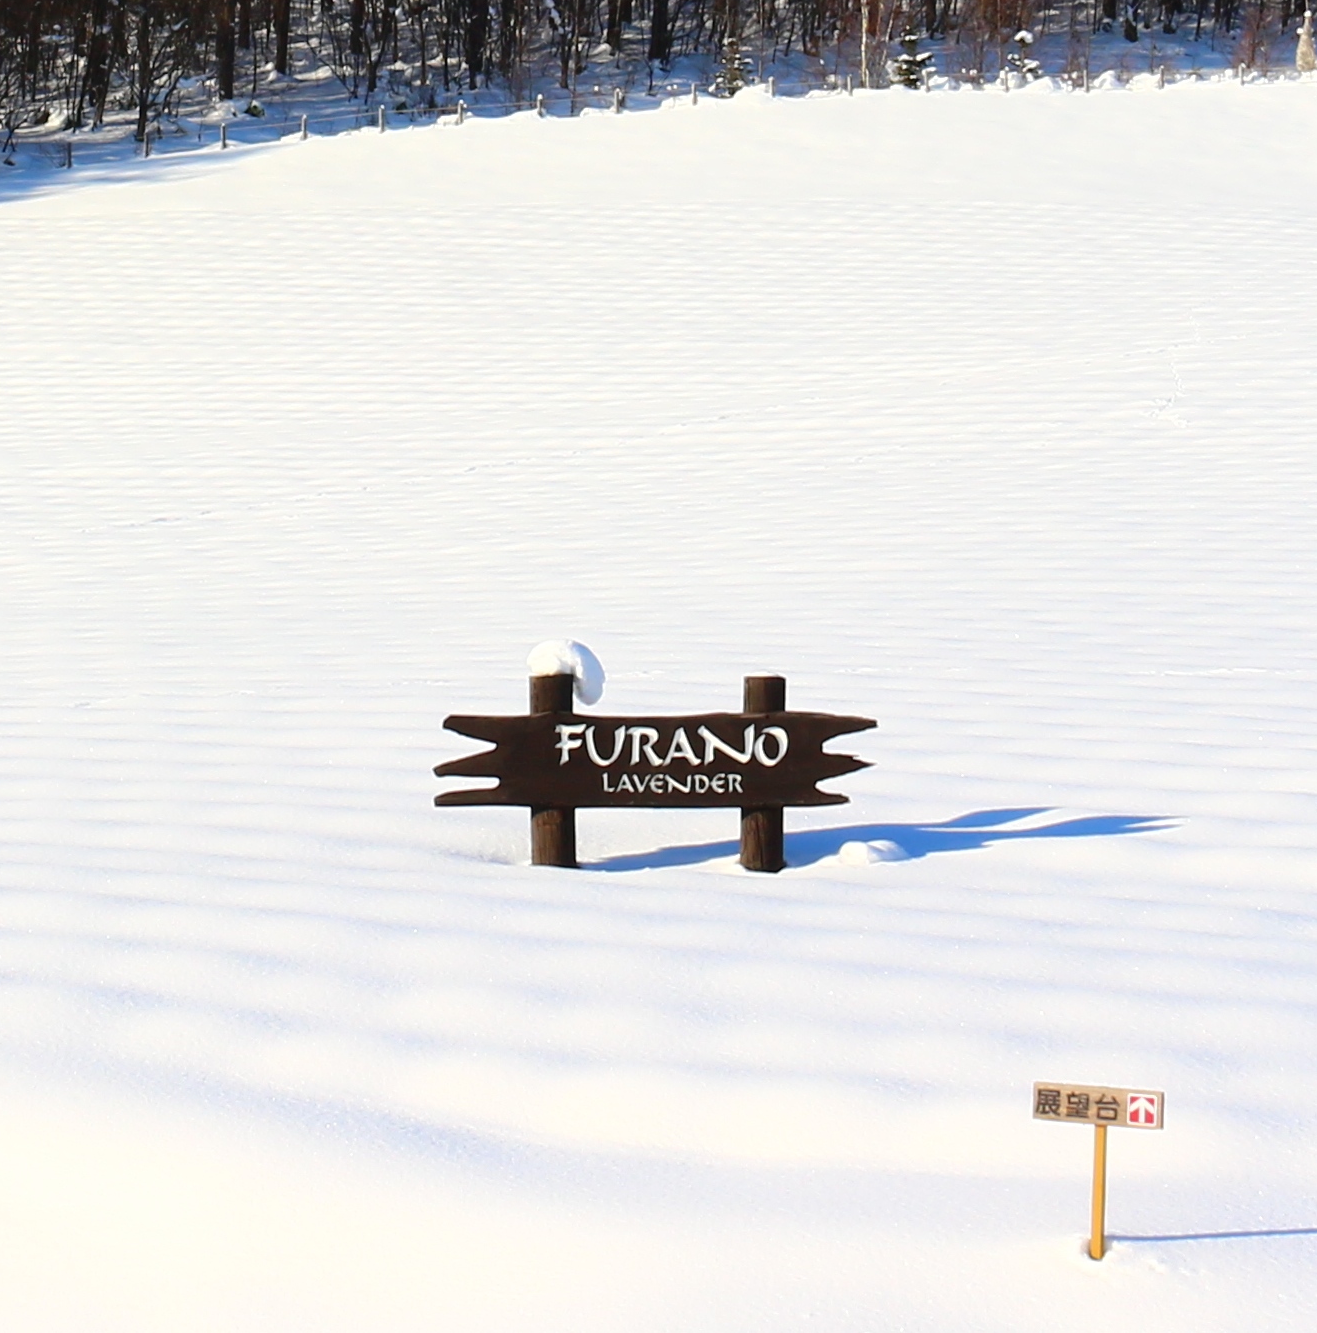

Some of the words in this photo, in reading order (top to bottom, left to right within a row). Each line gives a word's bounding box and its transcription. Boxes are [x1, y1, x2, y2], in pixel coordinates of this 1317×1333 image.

[555, 723, 790, 767] FURANO
[602, 772, 744, 794] LAVENDER
[1035, 1088, 1120, 1120] 展望台
